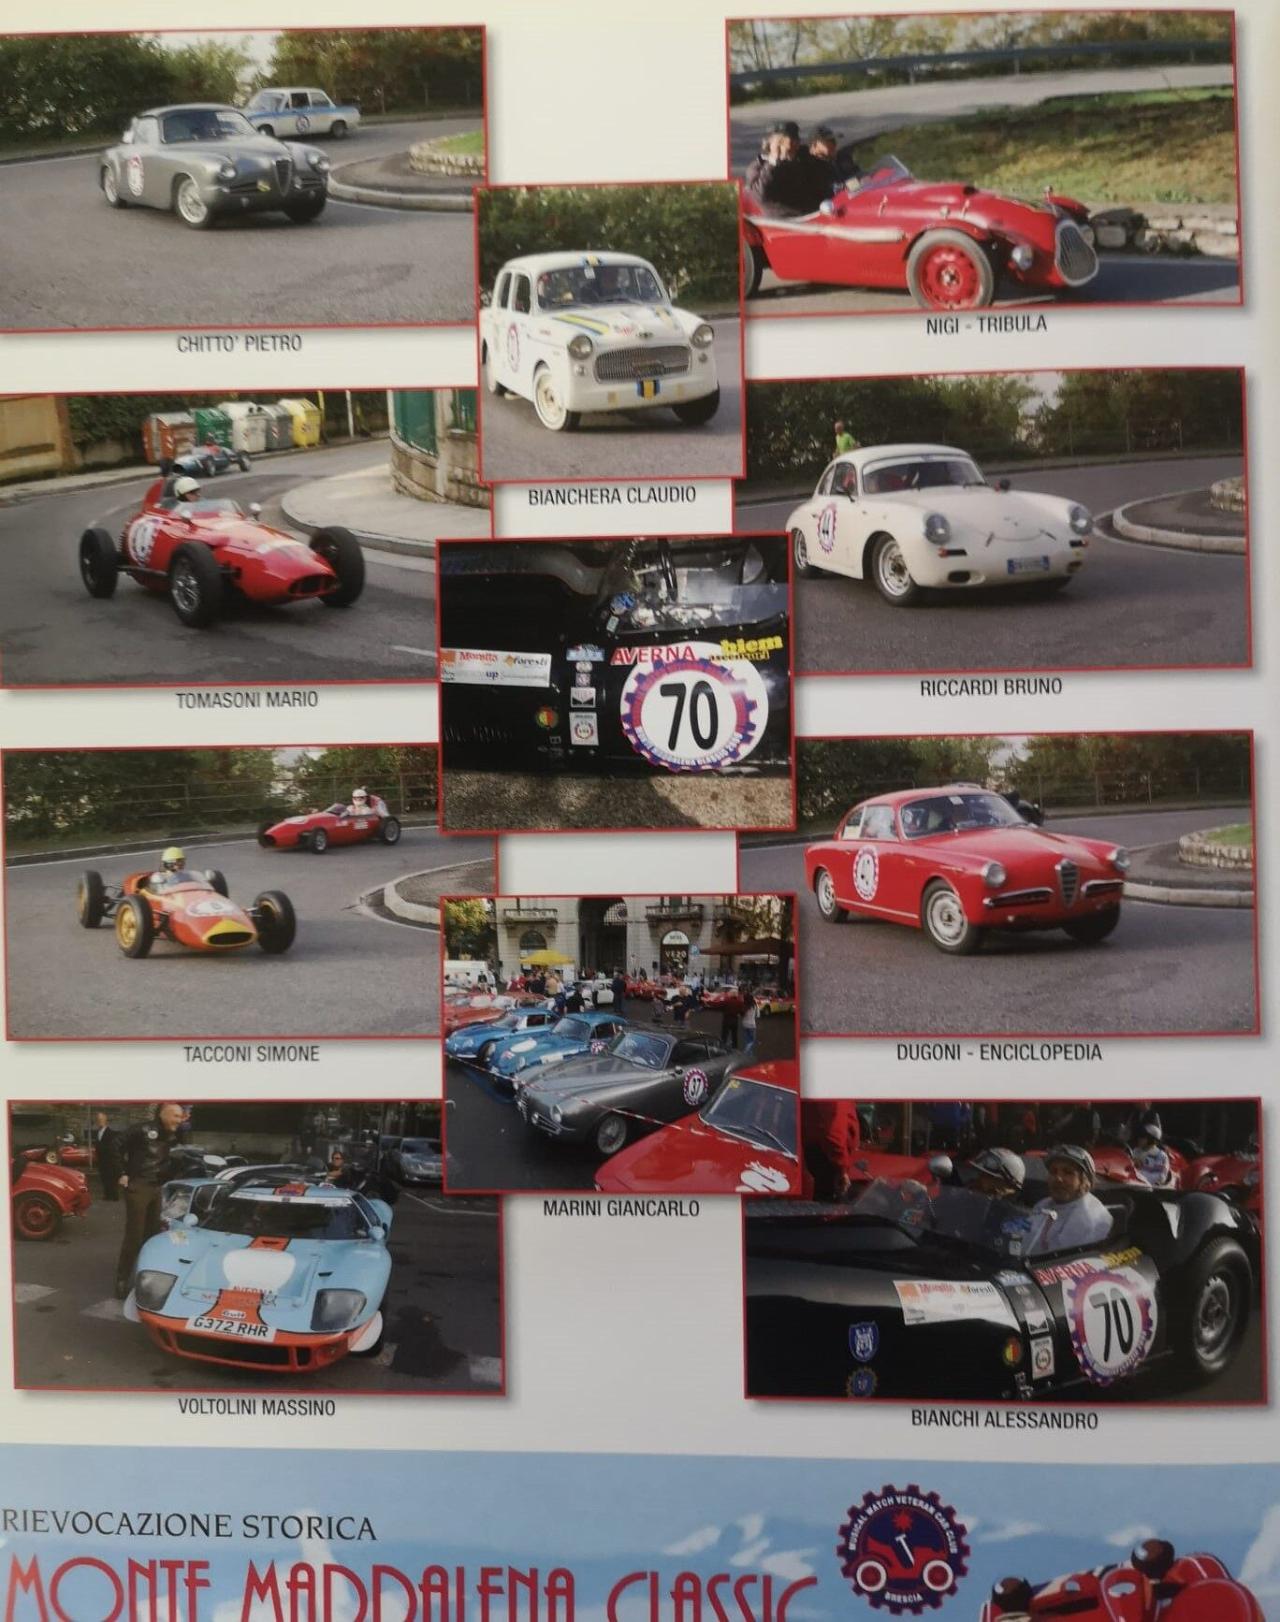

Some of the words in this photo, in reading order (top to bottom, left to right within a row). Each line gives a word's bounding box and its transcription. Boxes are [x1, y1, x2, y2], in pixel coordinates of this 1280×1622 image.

[926, 317, 959, 335] NIGI
[979, 315, 1048, 333] TRIBULA
[177, 335, 240, 353] CHITTO'
[244, 335, 303, 352] PIETRO
[528, 487, 622, 506] BIANCHERA
[626, 486, 697, 504] CLAUDIO
[610, 646, 696, 666] AVERNA
[920, 678, 998, 696] RICCARDI
[1003, 677, 1063, 695] BRUNO
[176, 691, 261, 709] TOMASONI
[266, 690, 319, 707] MARIO
[660, 680, 719, 751] 70
[183, 1045, 252, 1062] TACCONI
[257, 1045, 320, 1062] SIMONE
[896, 1043, 961, 1061] DUGONI
[980, 1043, 1103, 1061] ENCICLOPEDIA
[690, 1077, 702, 1097] 37
[543, 1199, 601, 1217] MARINI
[606, 1199, 700, 1217] GIANCARLO
[193, 1316, 235, 1332] G372
[236, 1322, 269, 1338] RHR
[1089, 1288, 1134, 1363] 70
[178, 1398, 257, 1416] VOLTOLINI
[261, 1399, 336, 1417] MASSINO
[911, 1408, 980, 1427] BIANCHI
[984, 1410, 1099, 1430] ALESSANDRO
[865, 1495, 894, 1516] WATCH
[895, 1495, 935, 1513] VETERAN
[2, 1508, 233, 1538] RIEVOCAZIONE
[242, 1514, 377, 1541] STORICA
[606, 1570, 818, 1622] CLASSIC
[884, 1591, 923, 1603] BRESCIA
